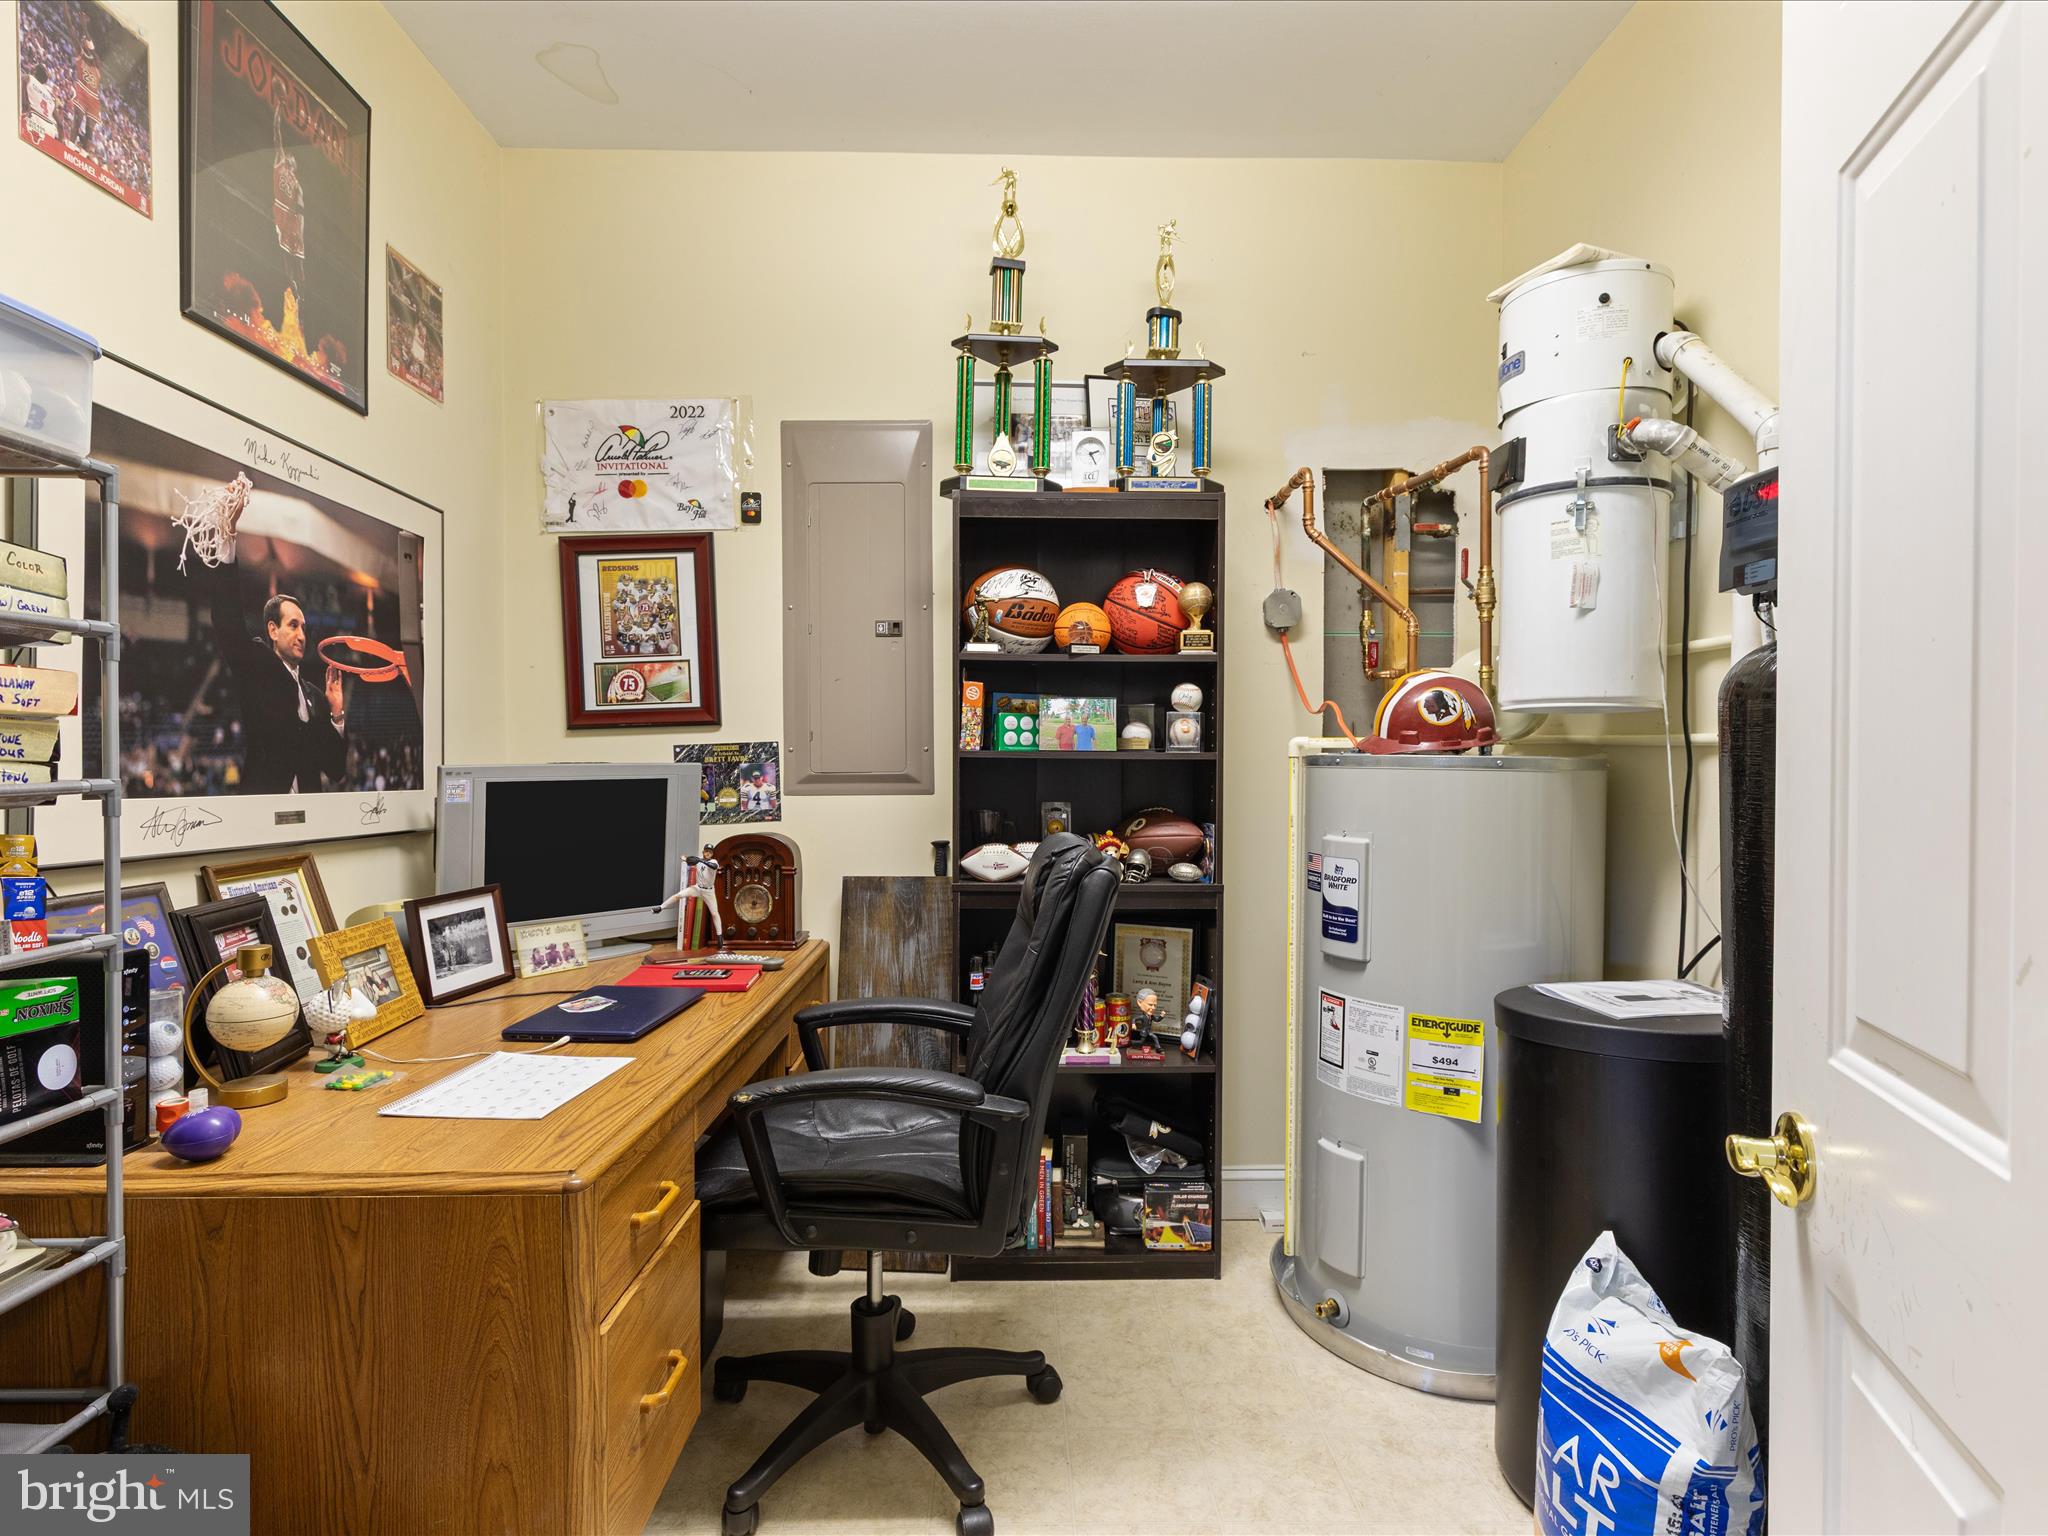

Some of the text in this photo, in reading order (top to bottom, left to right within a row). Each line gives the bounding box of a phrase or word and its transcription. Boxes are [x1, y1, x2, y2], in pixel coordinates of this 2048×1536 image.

[221, 28, 349, 177] JORDAN
[63, 150, 125, 196] MICHAEL JORDAN
[669, 405, 706, 420] 2022
[597, 462, 669, 471] INVITATIONAL
[677, 502, 692, 514] Bay
[7, 551, 43, 574] COLOR
[603, 592, 612, 642] WASHINGTON
[622, 678, 636, 691] 75
[752, 791, 761, 805] 4
[1324, 873, 1357, 884] BRADFORD
[1328, 881, 1348, 891] WHITE
[227, 881, 278, 897] Historical American
[13, 992, 75, 1023] SRIXON
[6, 1044, 17, 1063] GOLF
[1432, 1056, 1459, 1067] $494
[11, 1079, 22, 1114] PELOTAS
[86, 1141, 104, 1150] xfinity
[1579, 1338, 1606, 1364] PICK
[1732, 1402, 1741, 1424] PICK
